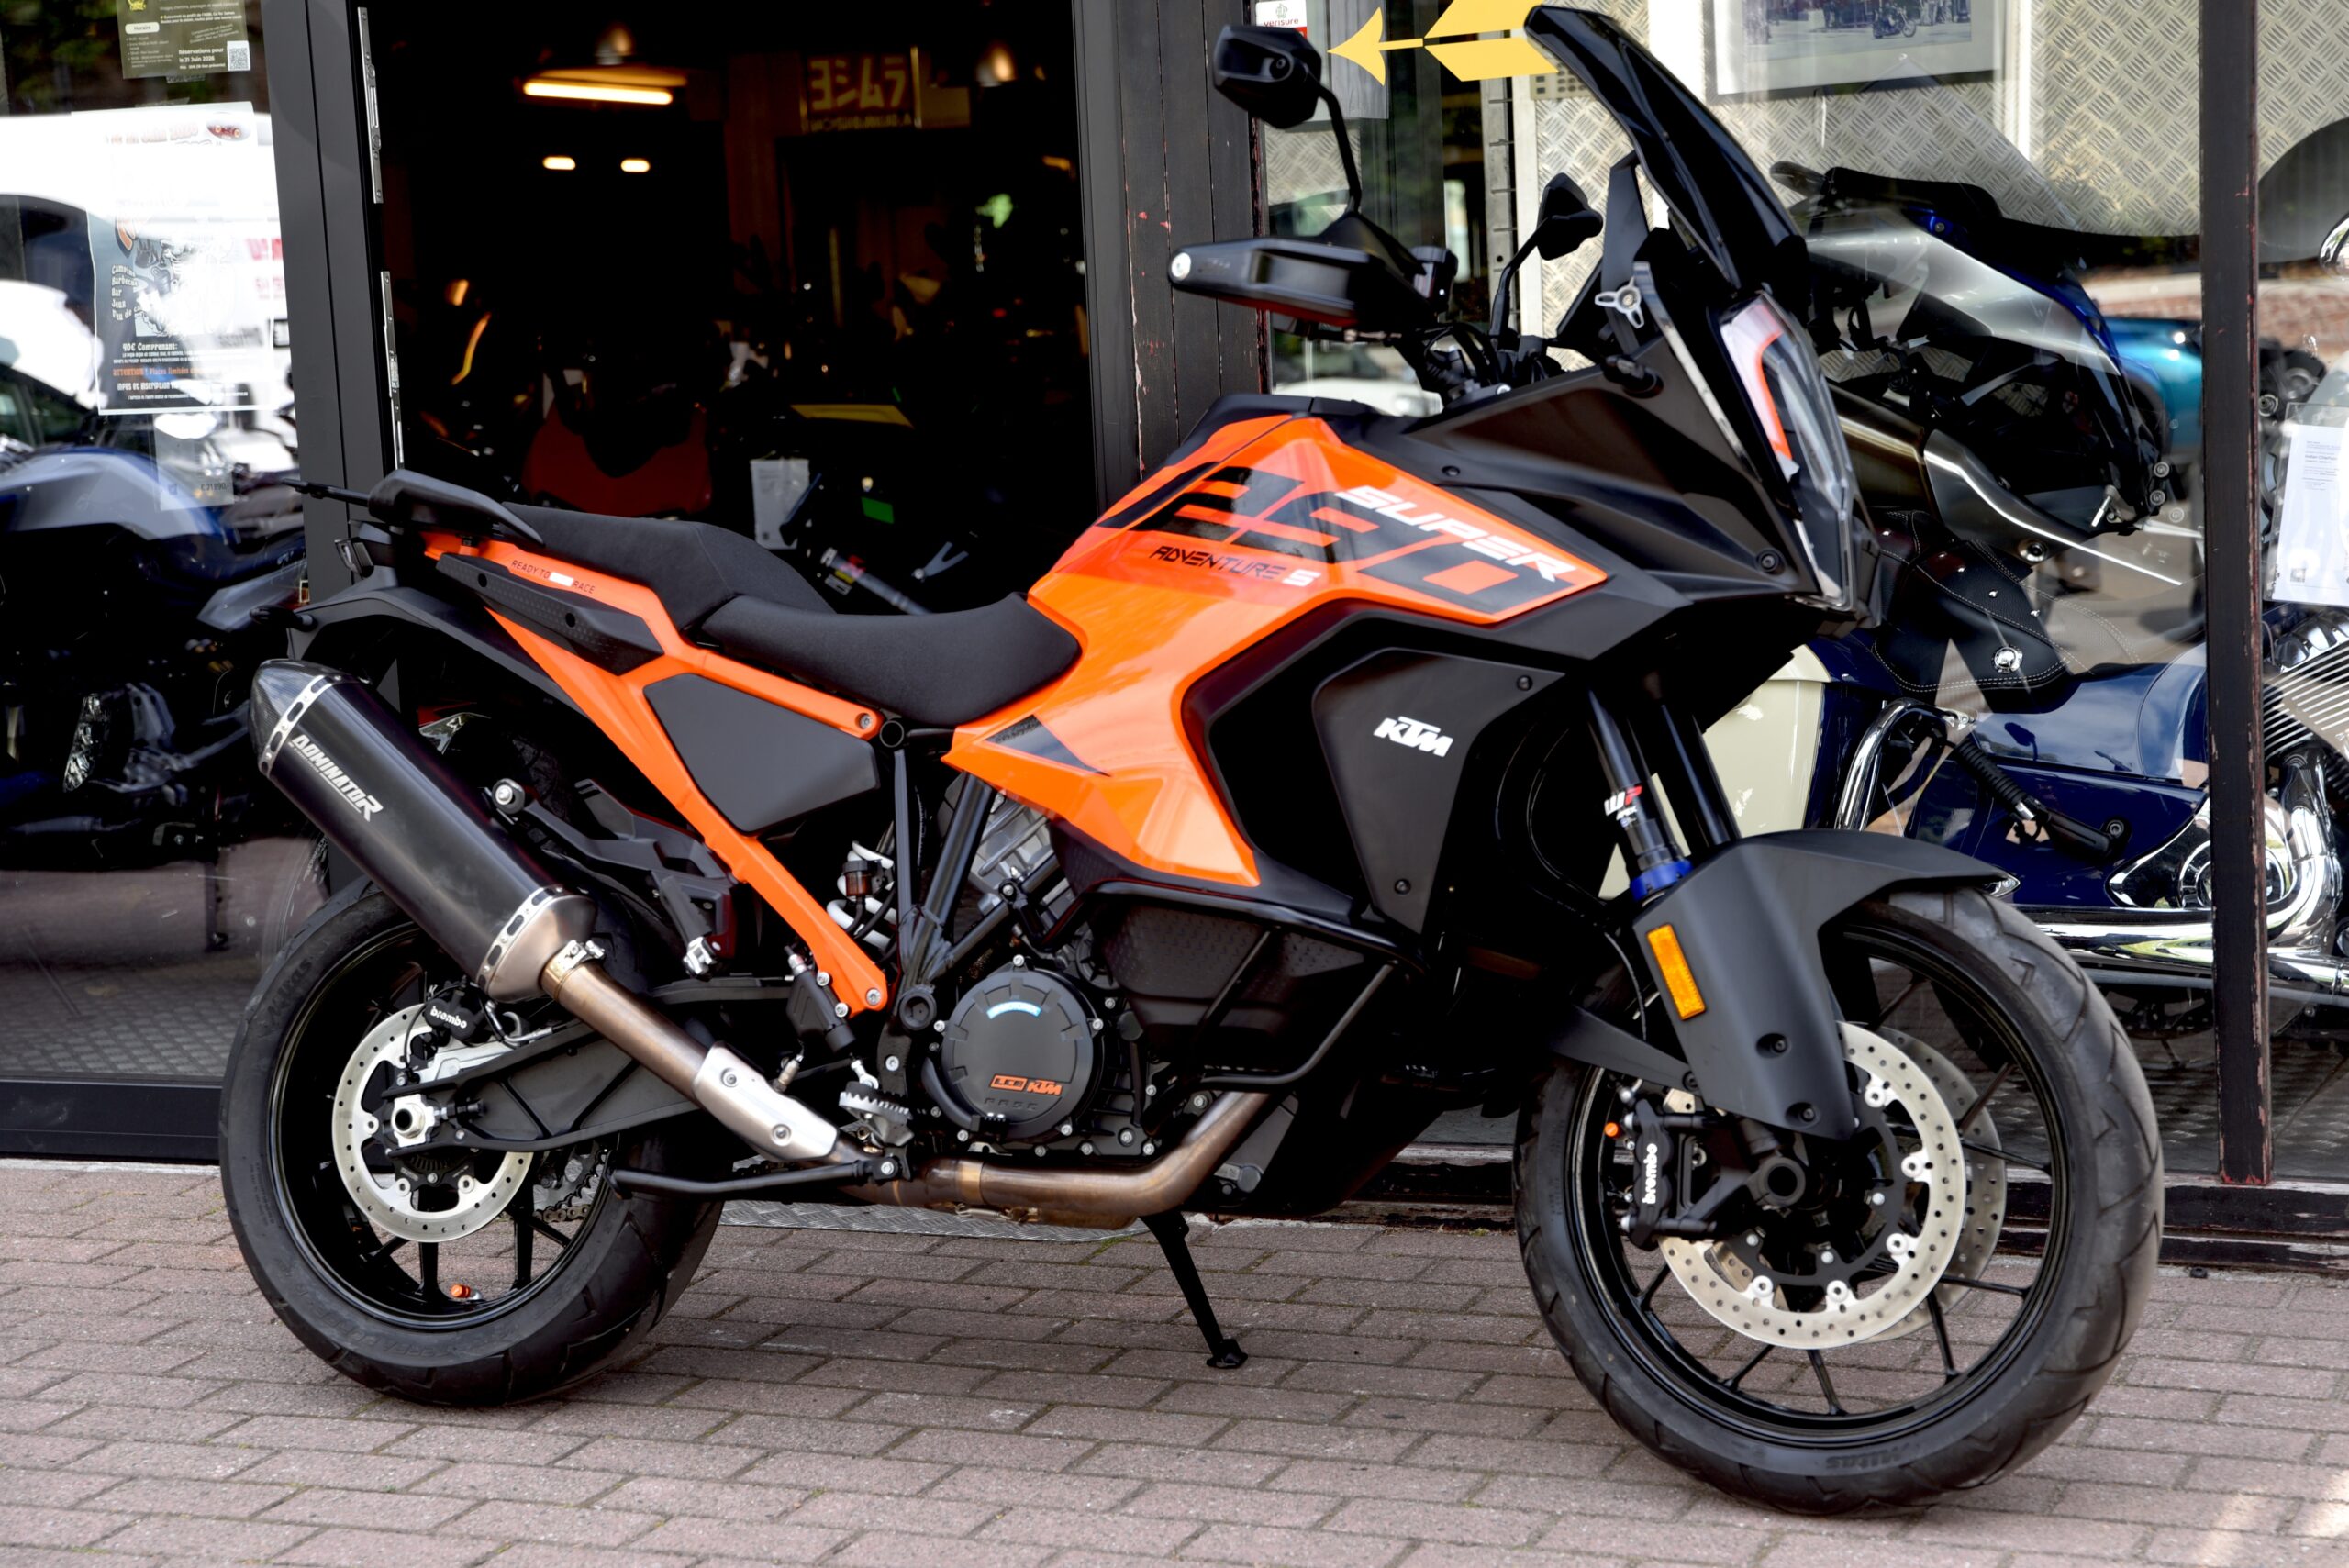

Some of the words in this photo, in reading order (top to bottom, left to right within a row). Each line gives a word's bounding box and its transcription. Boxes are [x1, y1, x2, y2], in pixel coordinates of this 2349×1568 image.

[1264, 17, 1299, 28] verisure
[810, 57, 907, 110] ヨシムラ
[1334, 485, 1578, 583] SUPER
[511, 559, 540, 574] READY
[540, 568, 551, 580] TO
[572, 580, 596, 595] RACE
[1148, 545, 1287, 583] ADVENTURE
[1282, 568, 1321, 588] S
[1373, 716, 1454, 758] KTM
[291, 734, 384, 823] DOMINATOR
[1604, 785, 1642, 817] WP
[429, 1005, 468, 1029] brembo
[1026, 1078, 1063, 1096] KTM
[1641, 1142, 1658, 1205] brembo
